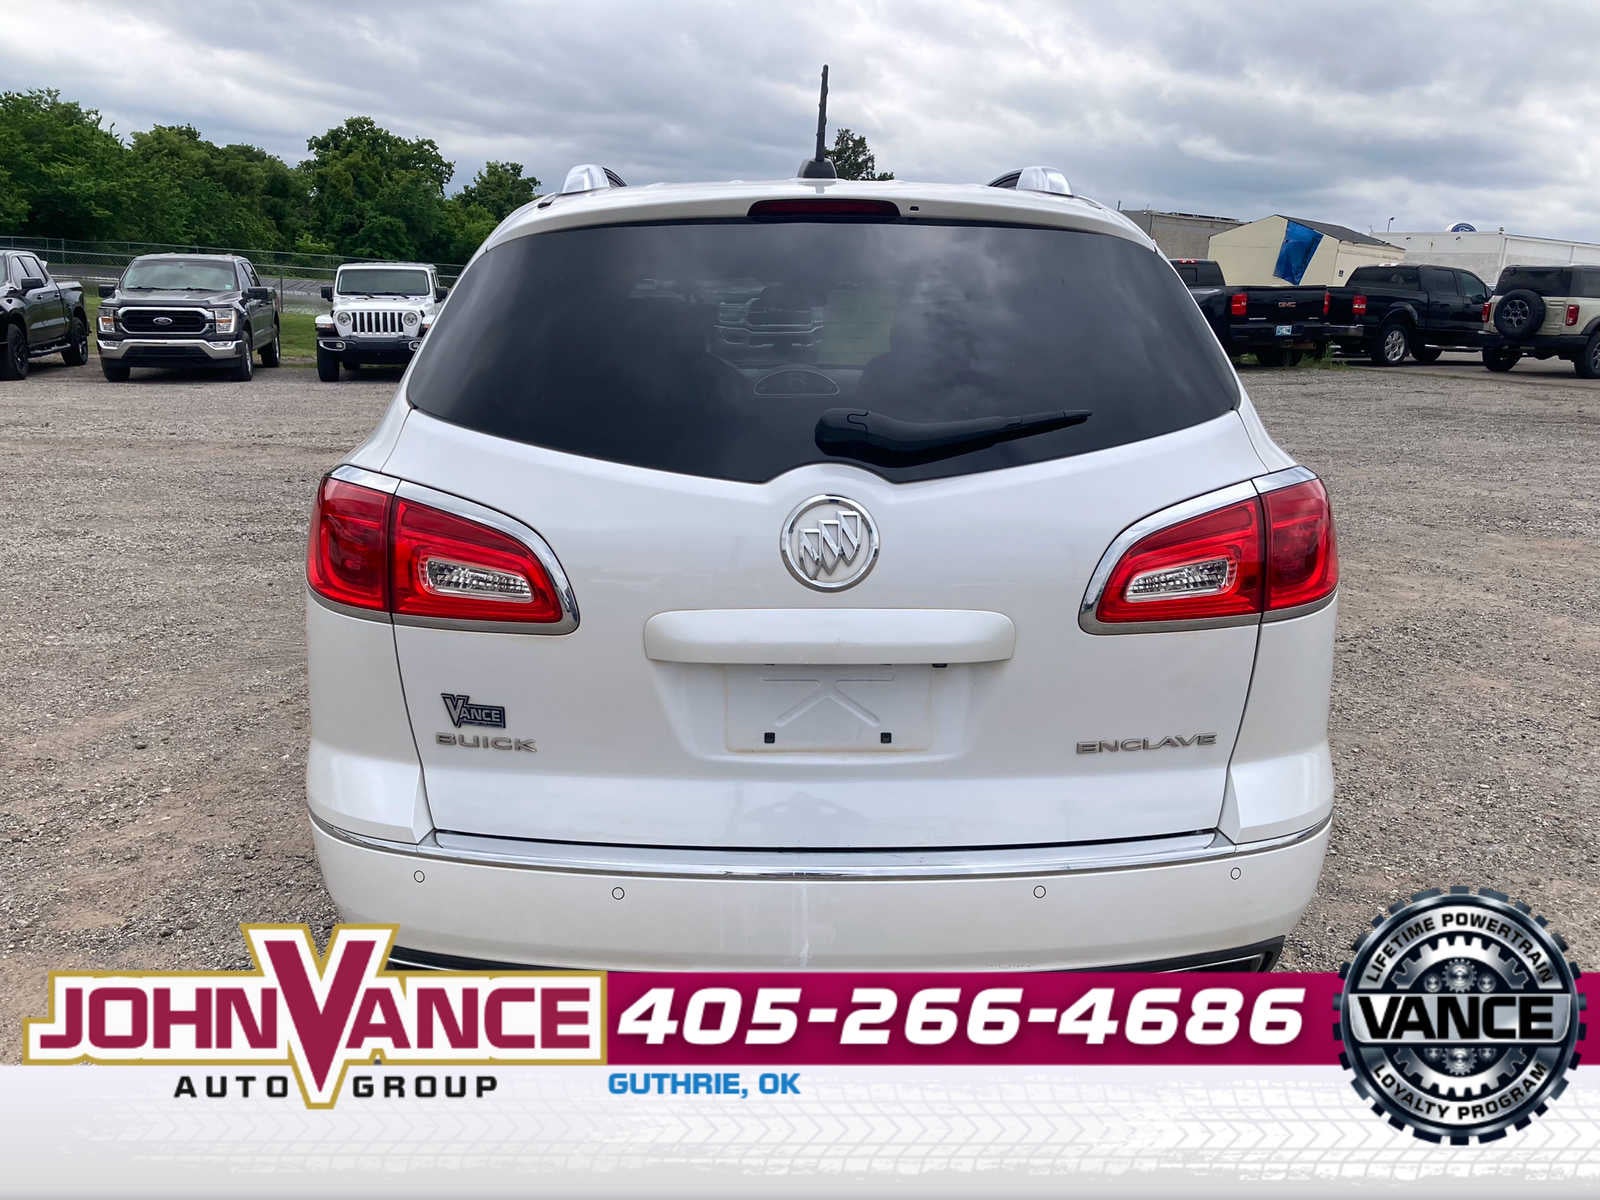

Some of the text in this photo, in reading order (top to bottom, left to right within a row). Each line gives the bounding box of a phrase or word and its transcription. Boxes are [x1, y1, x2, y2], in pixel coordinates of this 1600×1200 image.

[441, 693, 501, 728] VANCE
[435, 732, 538, 753] BUICK
[1076, 732, 1217, 754] ENCLAVE
